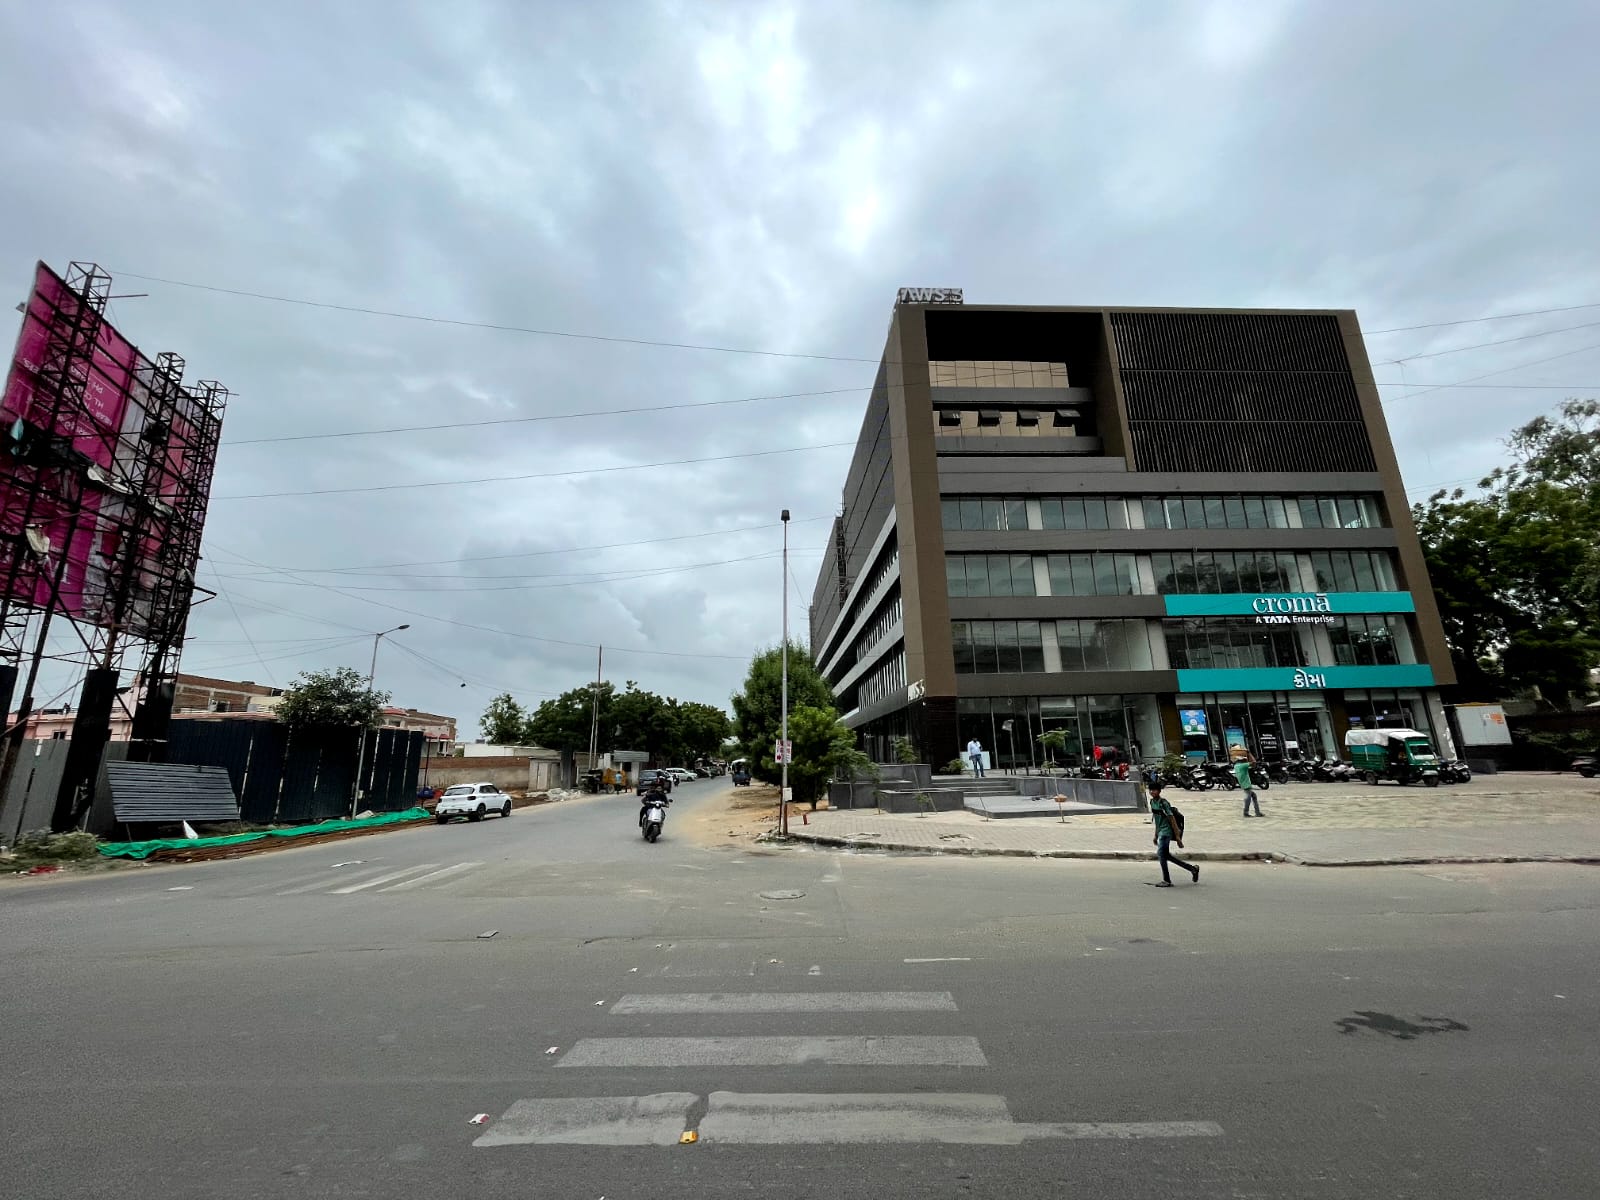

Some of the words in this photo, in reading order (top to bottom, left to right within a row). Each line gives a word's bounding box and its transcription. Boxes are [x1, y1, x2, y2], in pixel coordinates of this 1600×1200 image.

[1256, 616, 1263, 624] A
[1263, 615, 1291, 624] TATA
[1292, 615, 1335, 625] Enterprise
[1293, 668, 1326, 688] ક્રોમા
